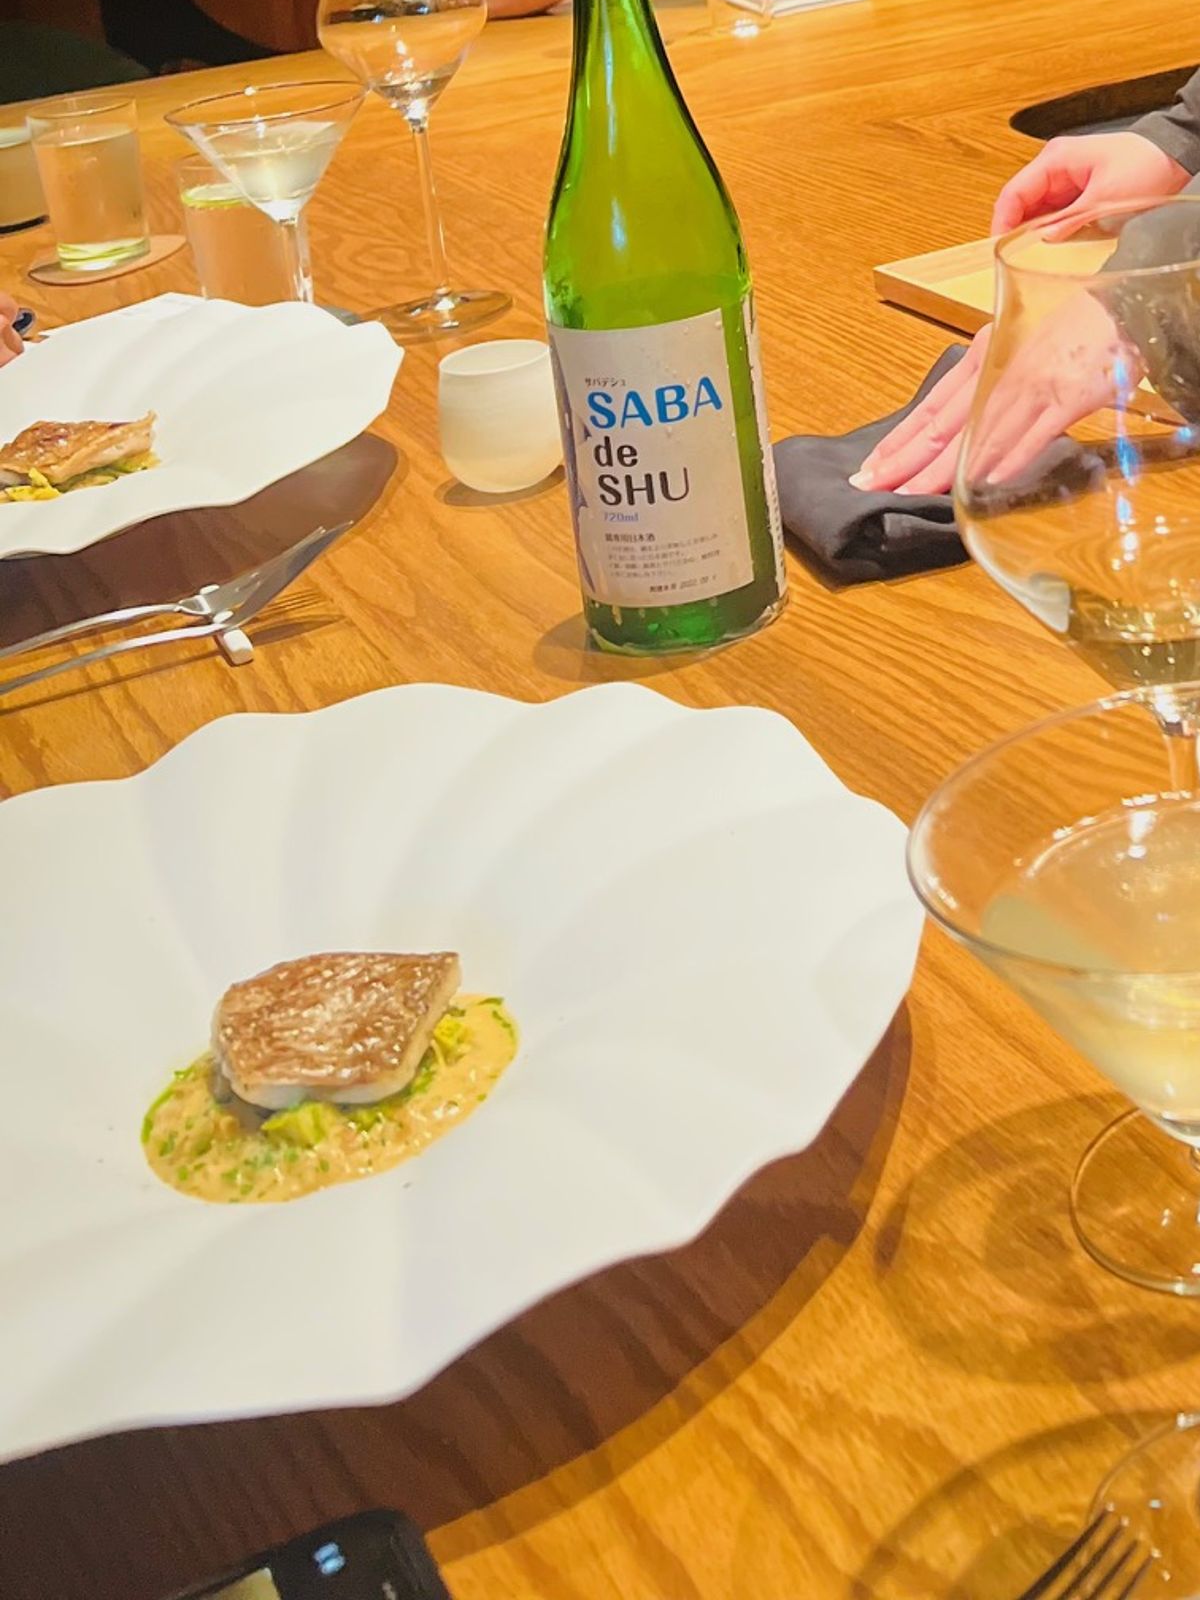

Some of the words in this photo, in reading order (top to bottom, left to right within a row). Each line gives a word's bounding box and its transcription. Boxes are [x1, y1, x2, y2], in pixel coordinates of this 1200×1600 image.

[587, 376, 723, 429] SABA
[593, 436, 638, 468] de
[598, 467, 690, 506] SHU
